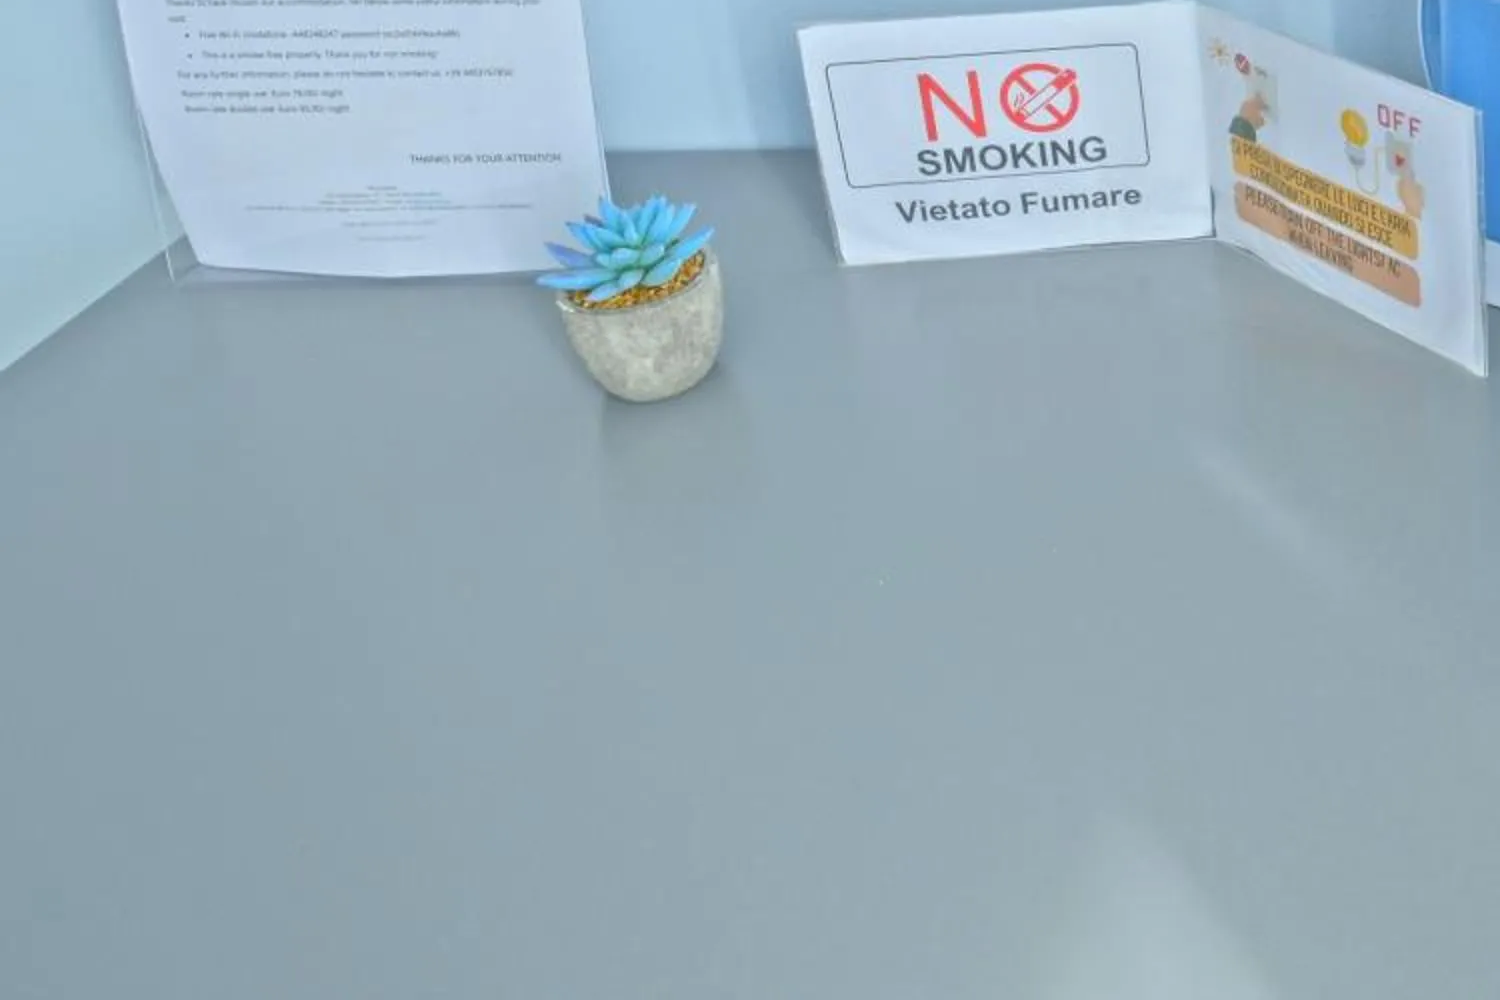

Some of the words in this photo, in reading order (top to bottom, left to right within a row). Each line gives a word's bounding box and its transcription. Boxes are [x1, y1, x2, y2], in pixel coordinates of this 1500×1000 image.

[1376, 103, 1422, 138] OFF
[917, 135, 1108, 176] SMOKING
[895, 195, 1011, 224] Vietato
[1021, 187, 1142, 215] Fumare
